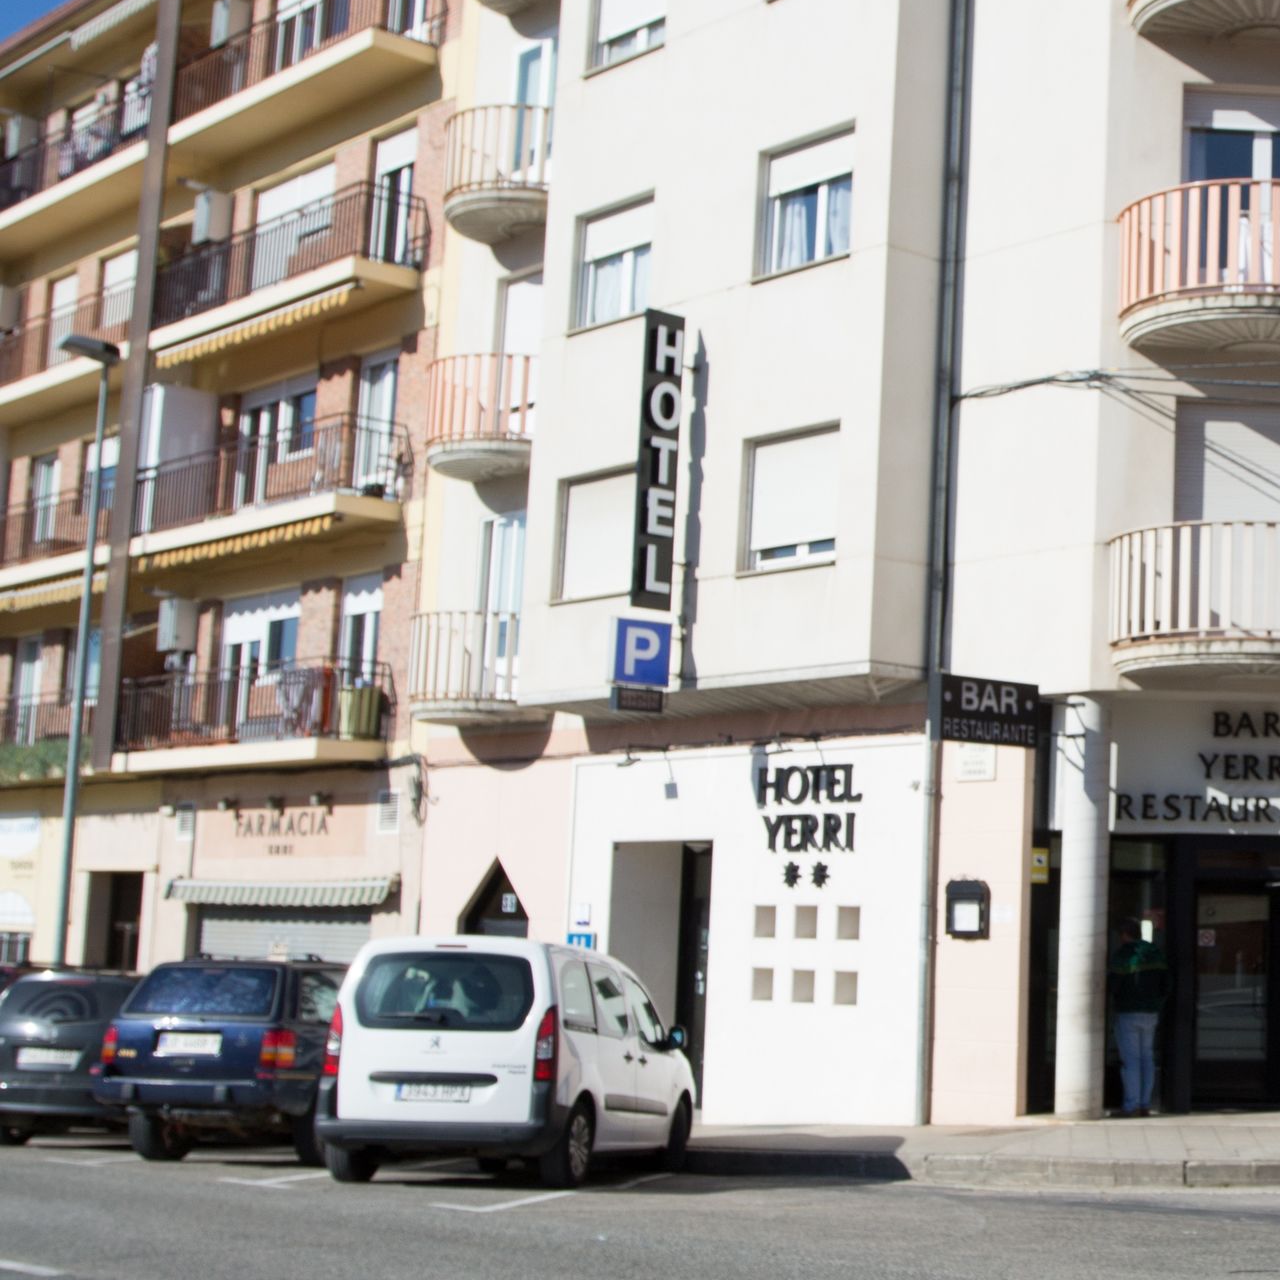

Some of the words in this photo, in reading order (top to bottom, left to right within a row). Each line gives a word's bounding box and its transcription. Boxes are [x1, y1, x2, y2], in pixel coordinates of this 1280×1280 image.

[645, 324, 684, 594] HOTEL
[624, 627, 661, 676] P
[961, 682, 1019, 716] BAR
[943, 718, 1036, 744] RESTAURANTE
[757, 763, 863, 806] HOTEL
[235, 810, 329, 837] FARMACIA
[762, 812, 857, 853] YERRI
